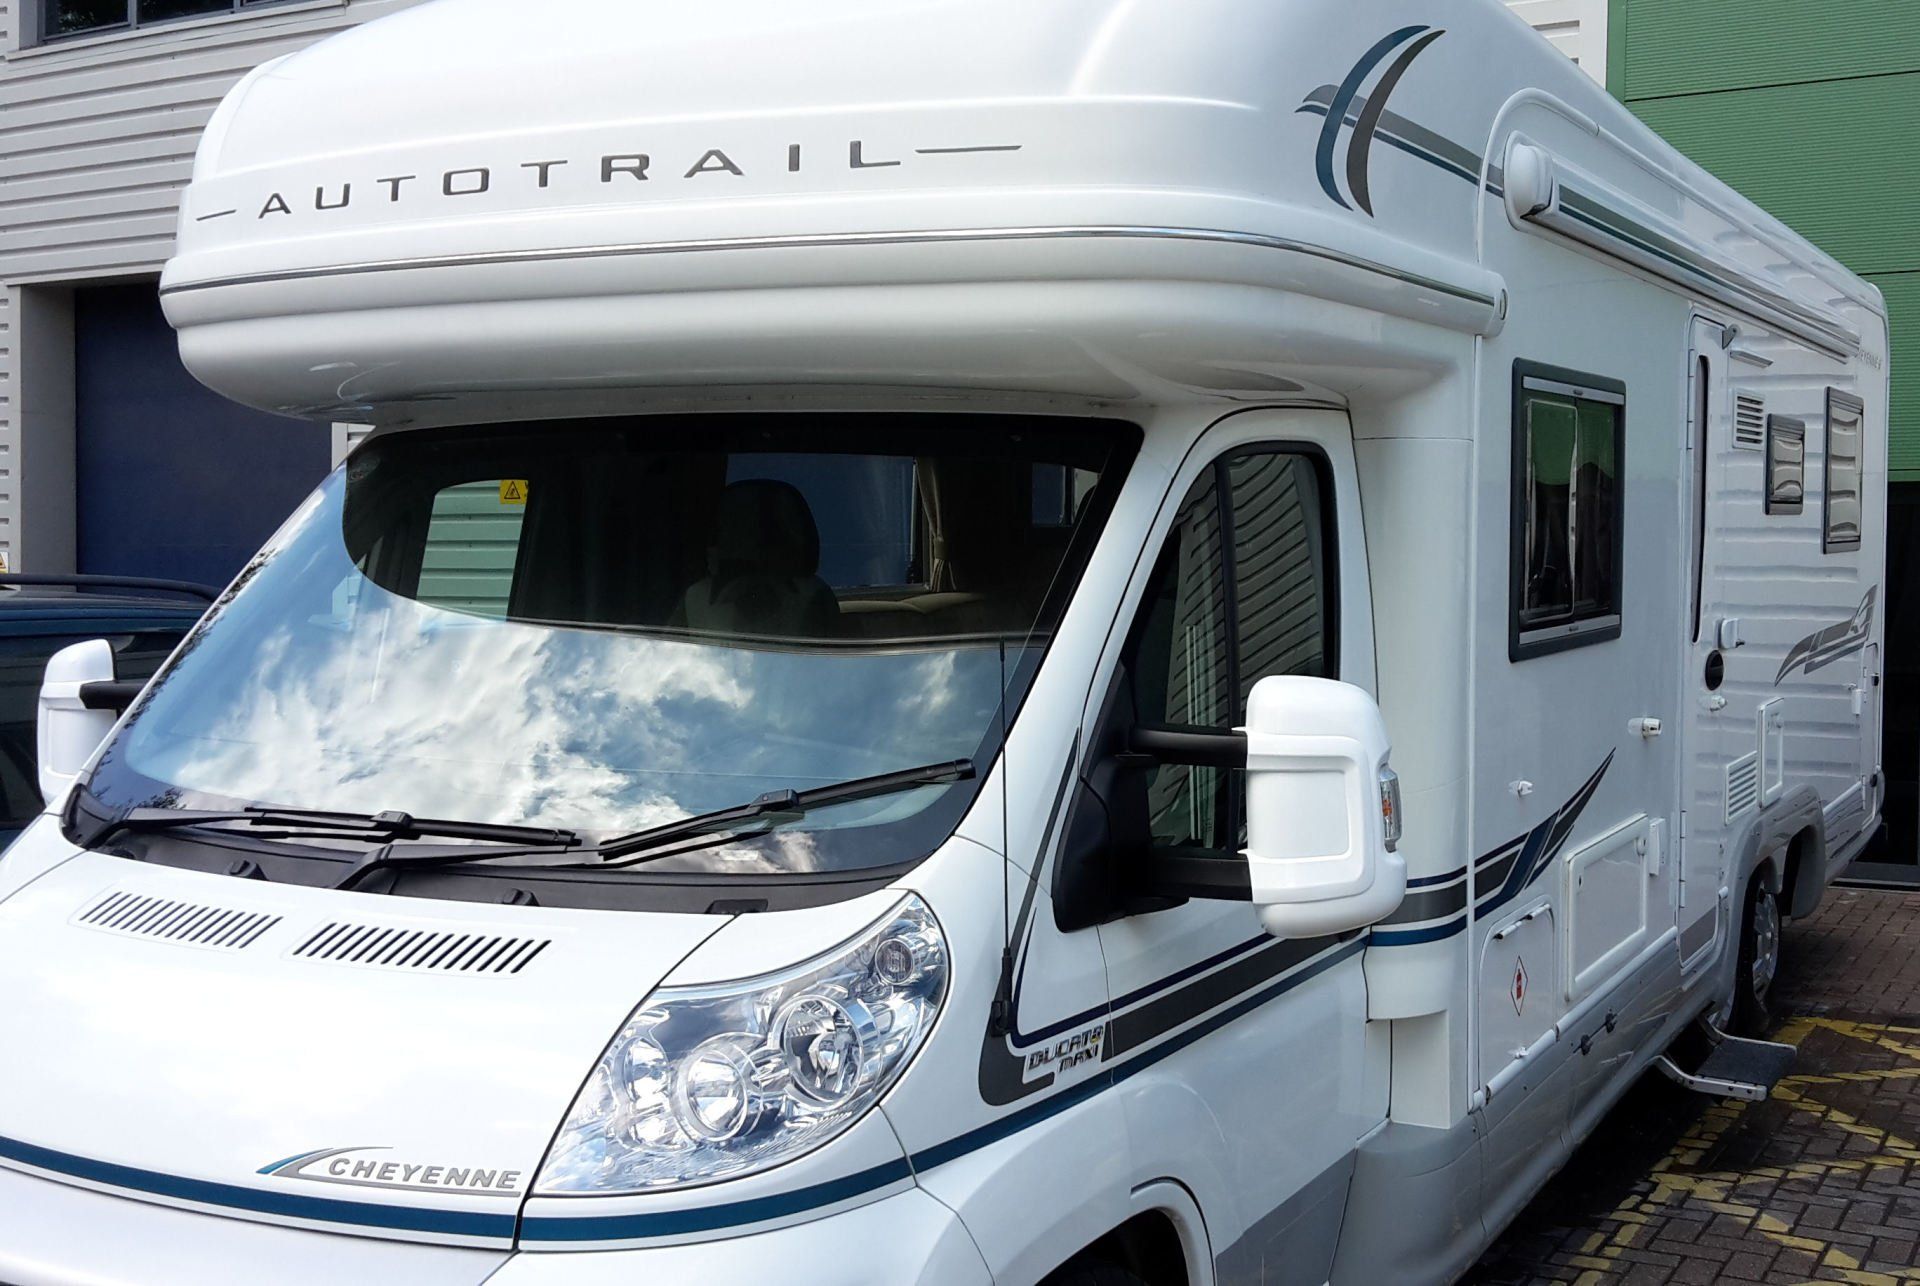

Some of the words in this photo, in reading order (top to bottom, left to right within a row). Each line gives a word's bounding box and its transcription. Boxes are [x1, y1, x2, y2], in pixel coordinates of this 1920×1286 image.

[258, 140, 901, 219] AUTOTRAIL
[1028, 1025, 1104, 1071] DUCATO
[328, 1157, 522, 1189] CHEYENNE
